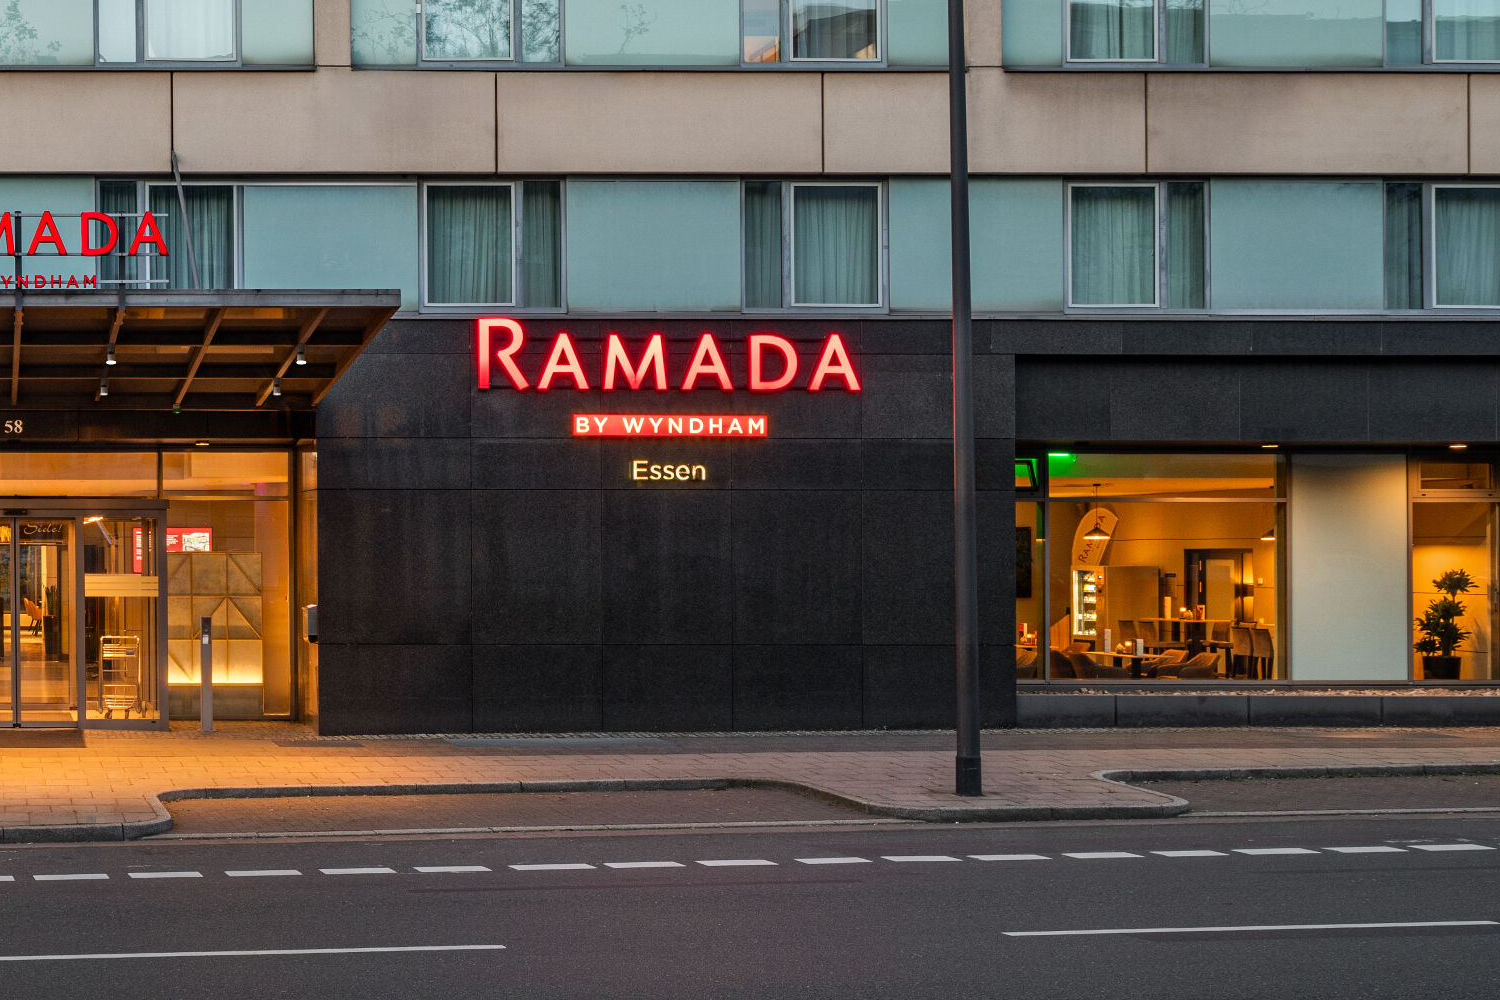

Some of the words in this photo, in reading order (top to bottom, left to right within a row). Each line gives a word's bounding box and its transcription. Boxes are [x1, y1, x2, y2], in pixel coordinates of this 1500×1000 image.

[476, 317, 862, 392] RAMADA
[4, 419, 23, 434] 58
[575, 416, 608, 434] BY
[622, 416, 766, 435] WYNDHAM
[631, 460, 706, 481] Essen
